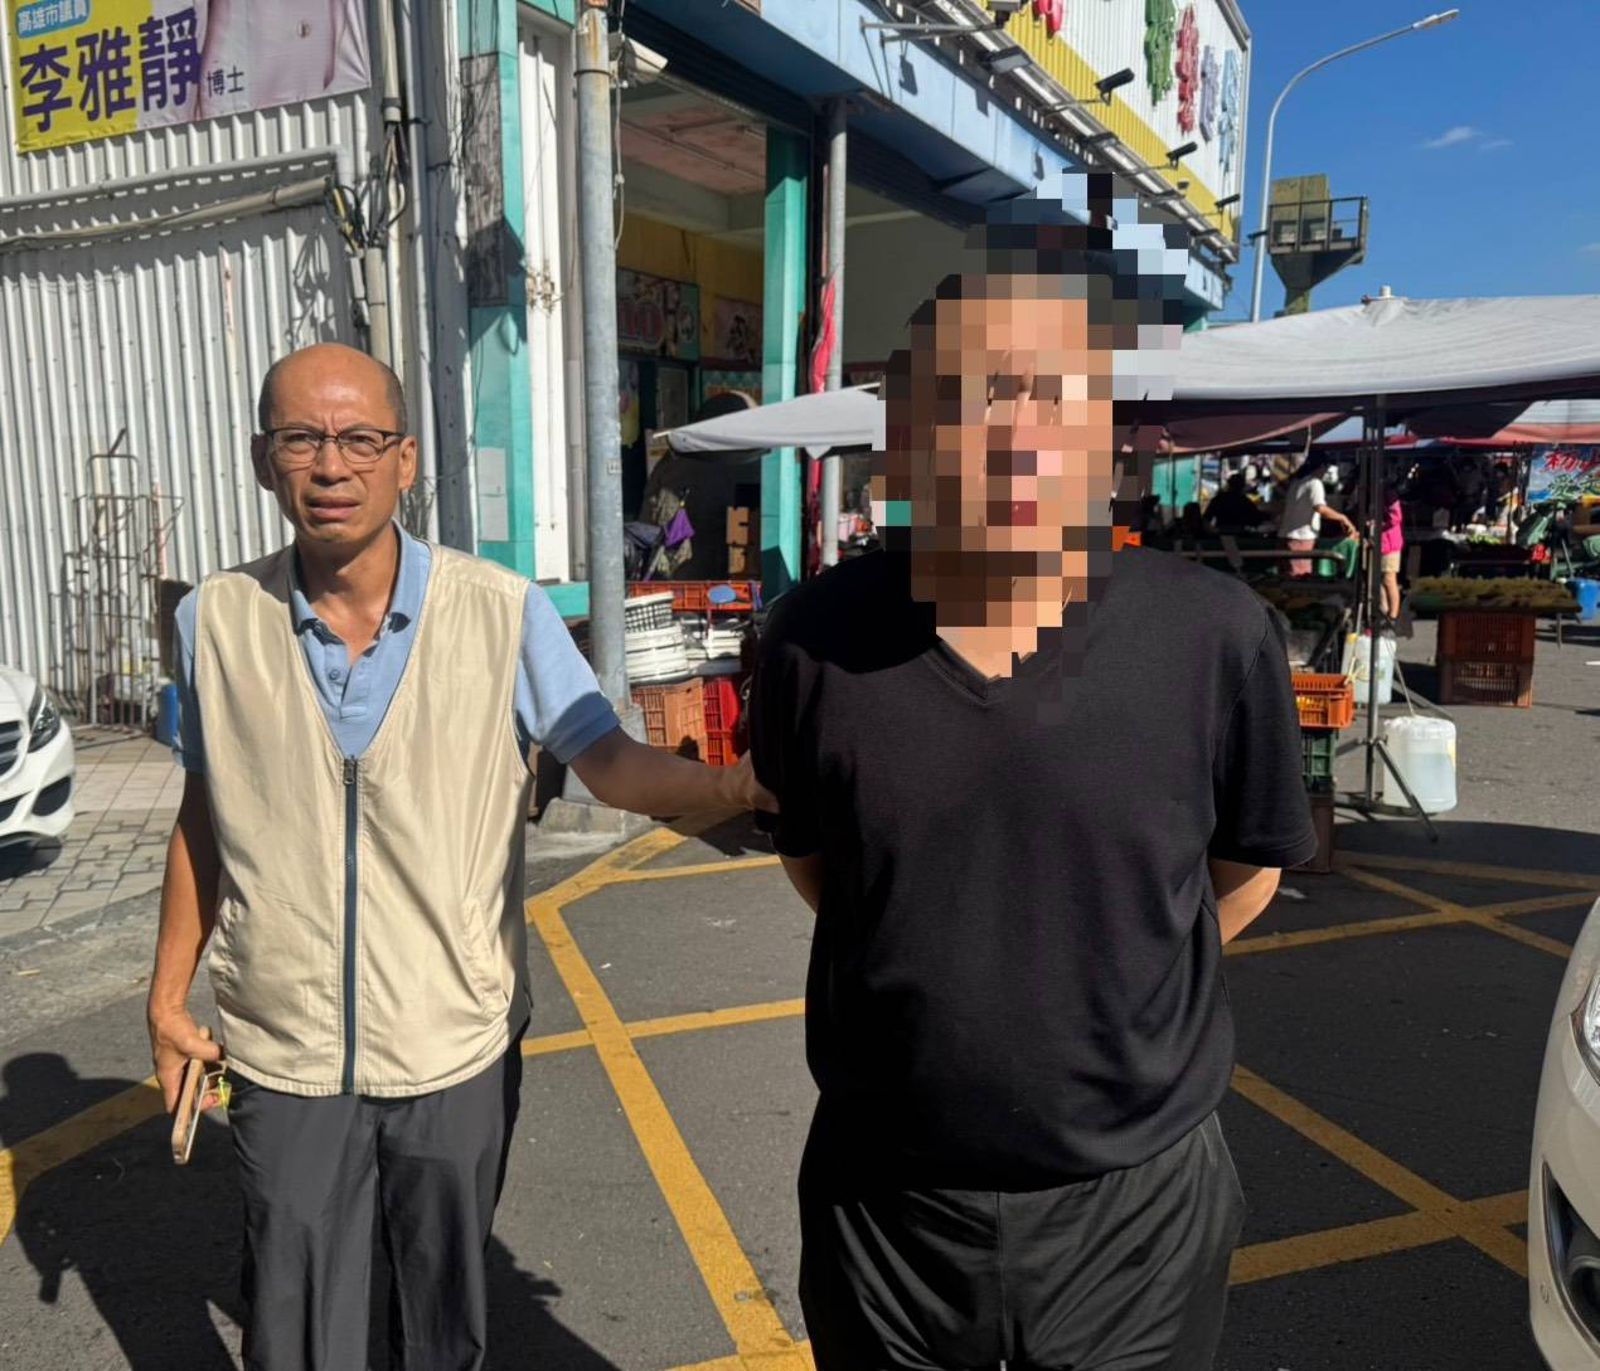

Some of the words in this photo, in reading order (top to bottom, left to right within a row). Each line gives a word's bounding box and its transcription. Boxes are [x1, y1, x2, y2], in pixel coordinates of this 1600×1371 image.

[18, 0, 88, 33] 高雄市議員
[20, 7, 202, 133] 李雅靜
[207, 66, 245, 97] 博士
